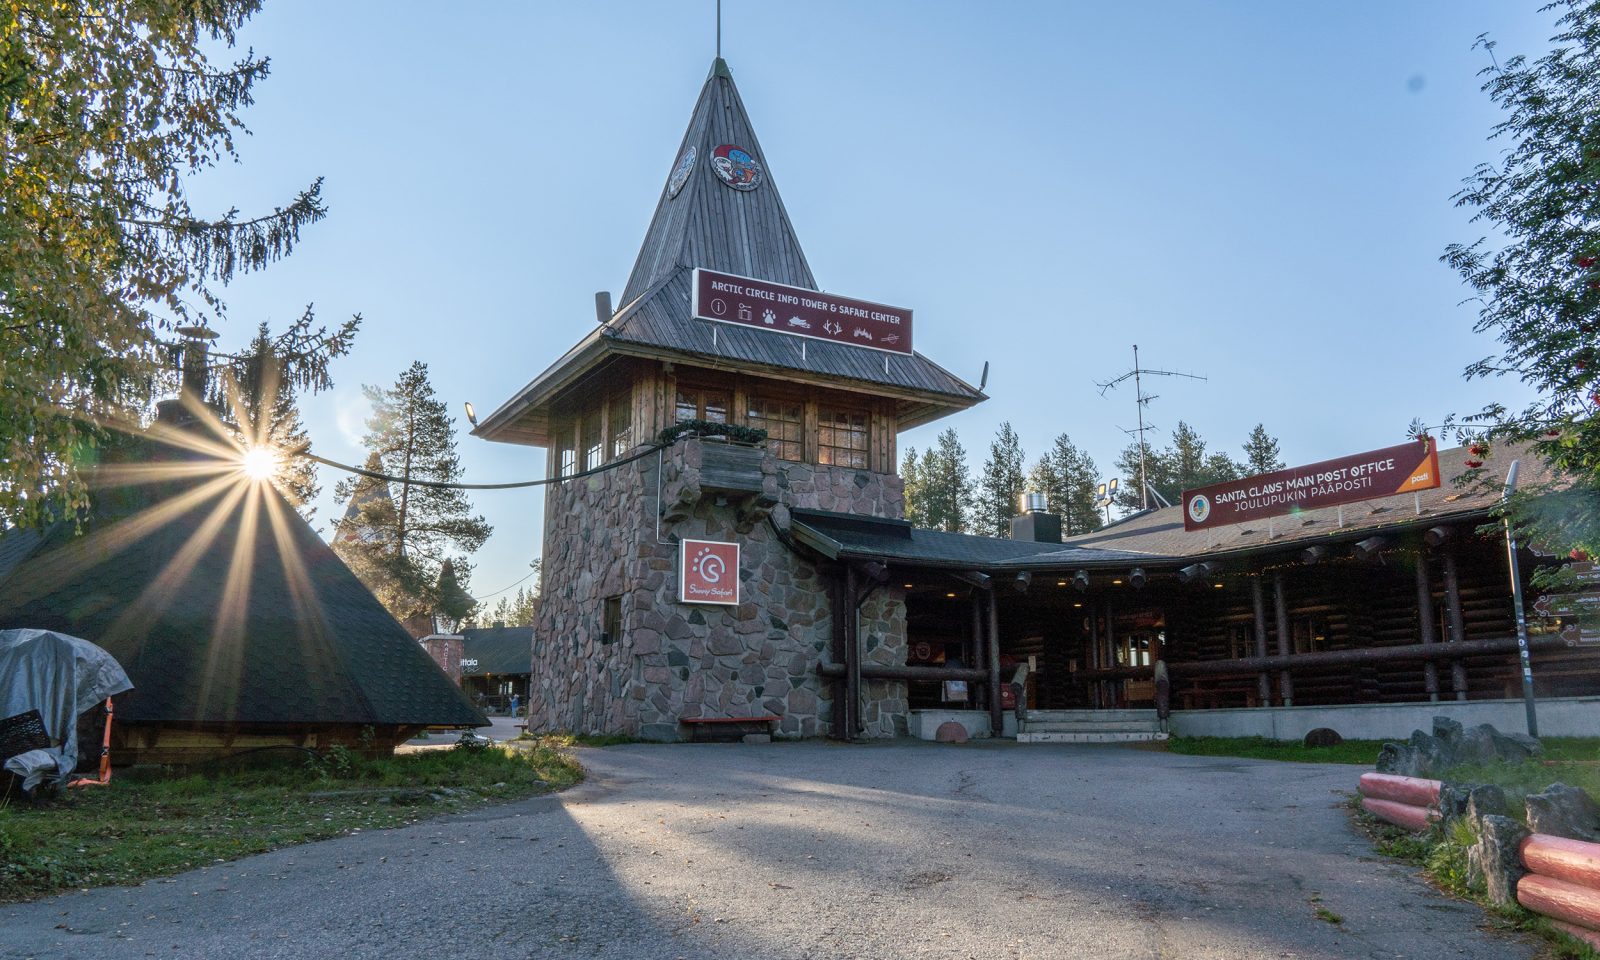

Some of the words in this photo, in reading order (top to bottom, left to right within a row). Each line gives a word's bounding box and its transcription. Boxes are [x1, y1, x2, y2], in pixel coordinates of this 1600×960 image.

[711, 280, 743, 295] ARCTIC
[745, 287, 775, 301] CIRCLE
[777, 293, 799, 305] INFO
[801, 298, 828, 311] TOWER
[830, 303, 837, 313] &
[839, 305, 869, 319] SAFARI
[871, 311, 901, 325] CENTER
[1215, 489, 1247, 504] SANTA
[1286, 474, 1315, 490] MAIN
[1317, 468, 1348, 484] POST
[1350, 458, 1395, 477] OFFICE
[1234, 489, 1307, 512] JOULUPUKIN
[1311, 476, 1372, 497] PÄÄPOSTI
[1411, 472, 1429, 485] posti
[689, 583, 710, 597] Sunny
[710, 587, 733, 598] Safari
